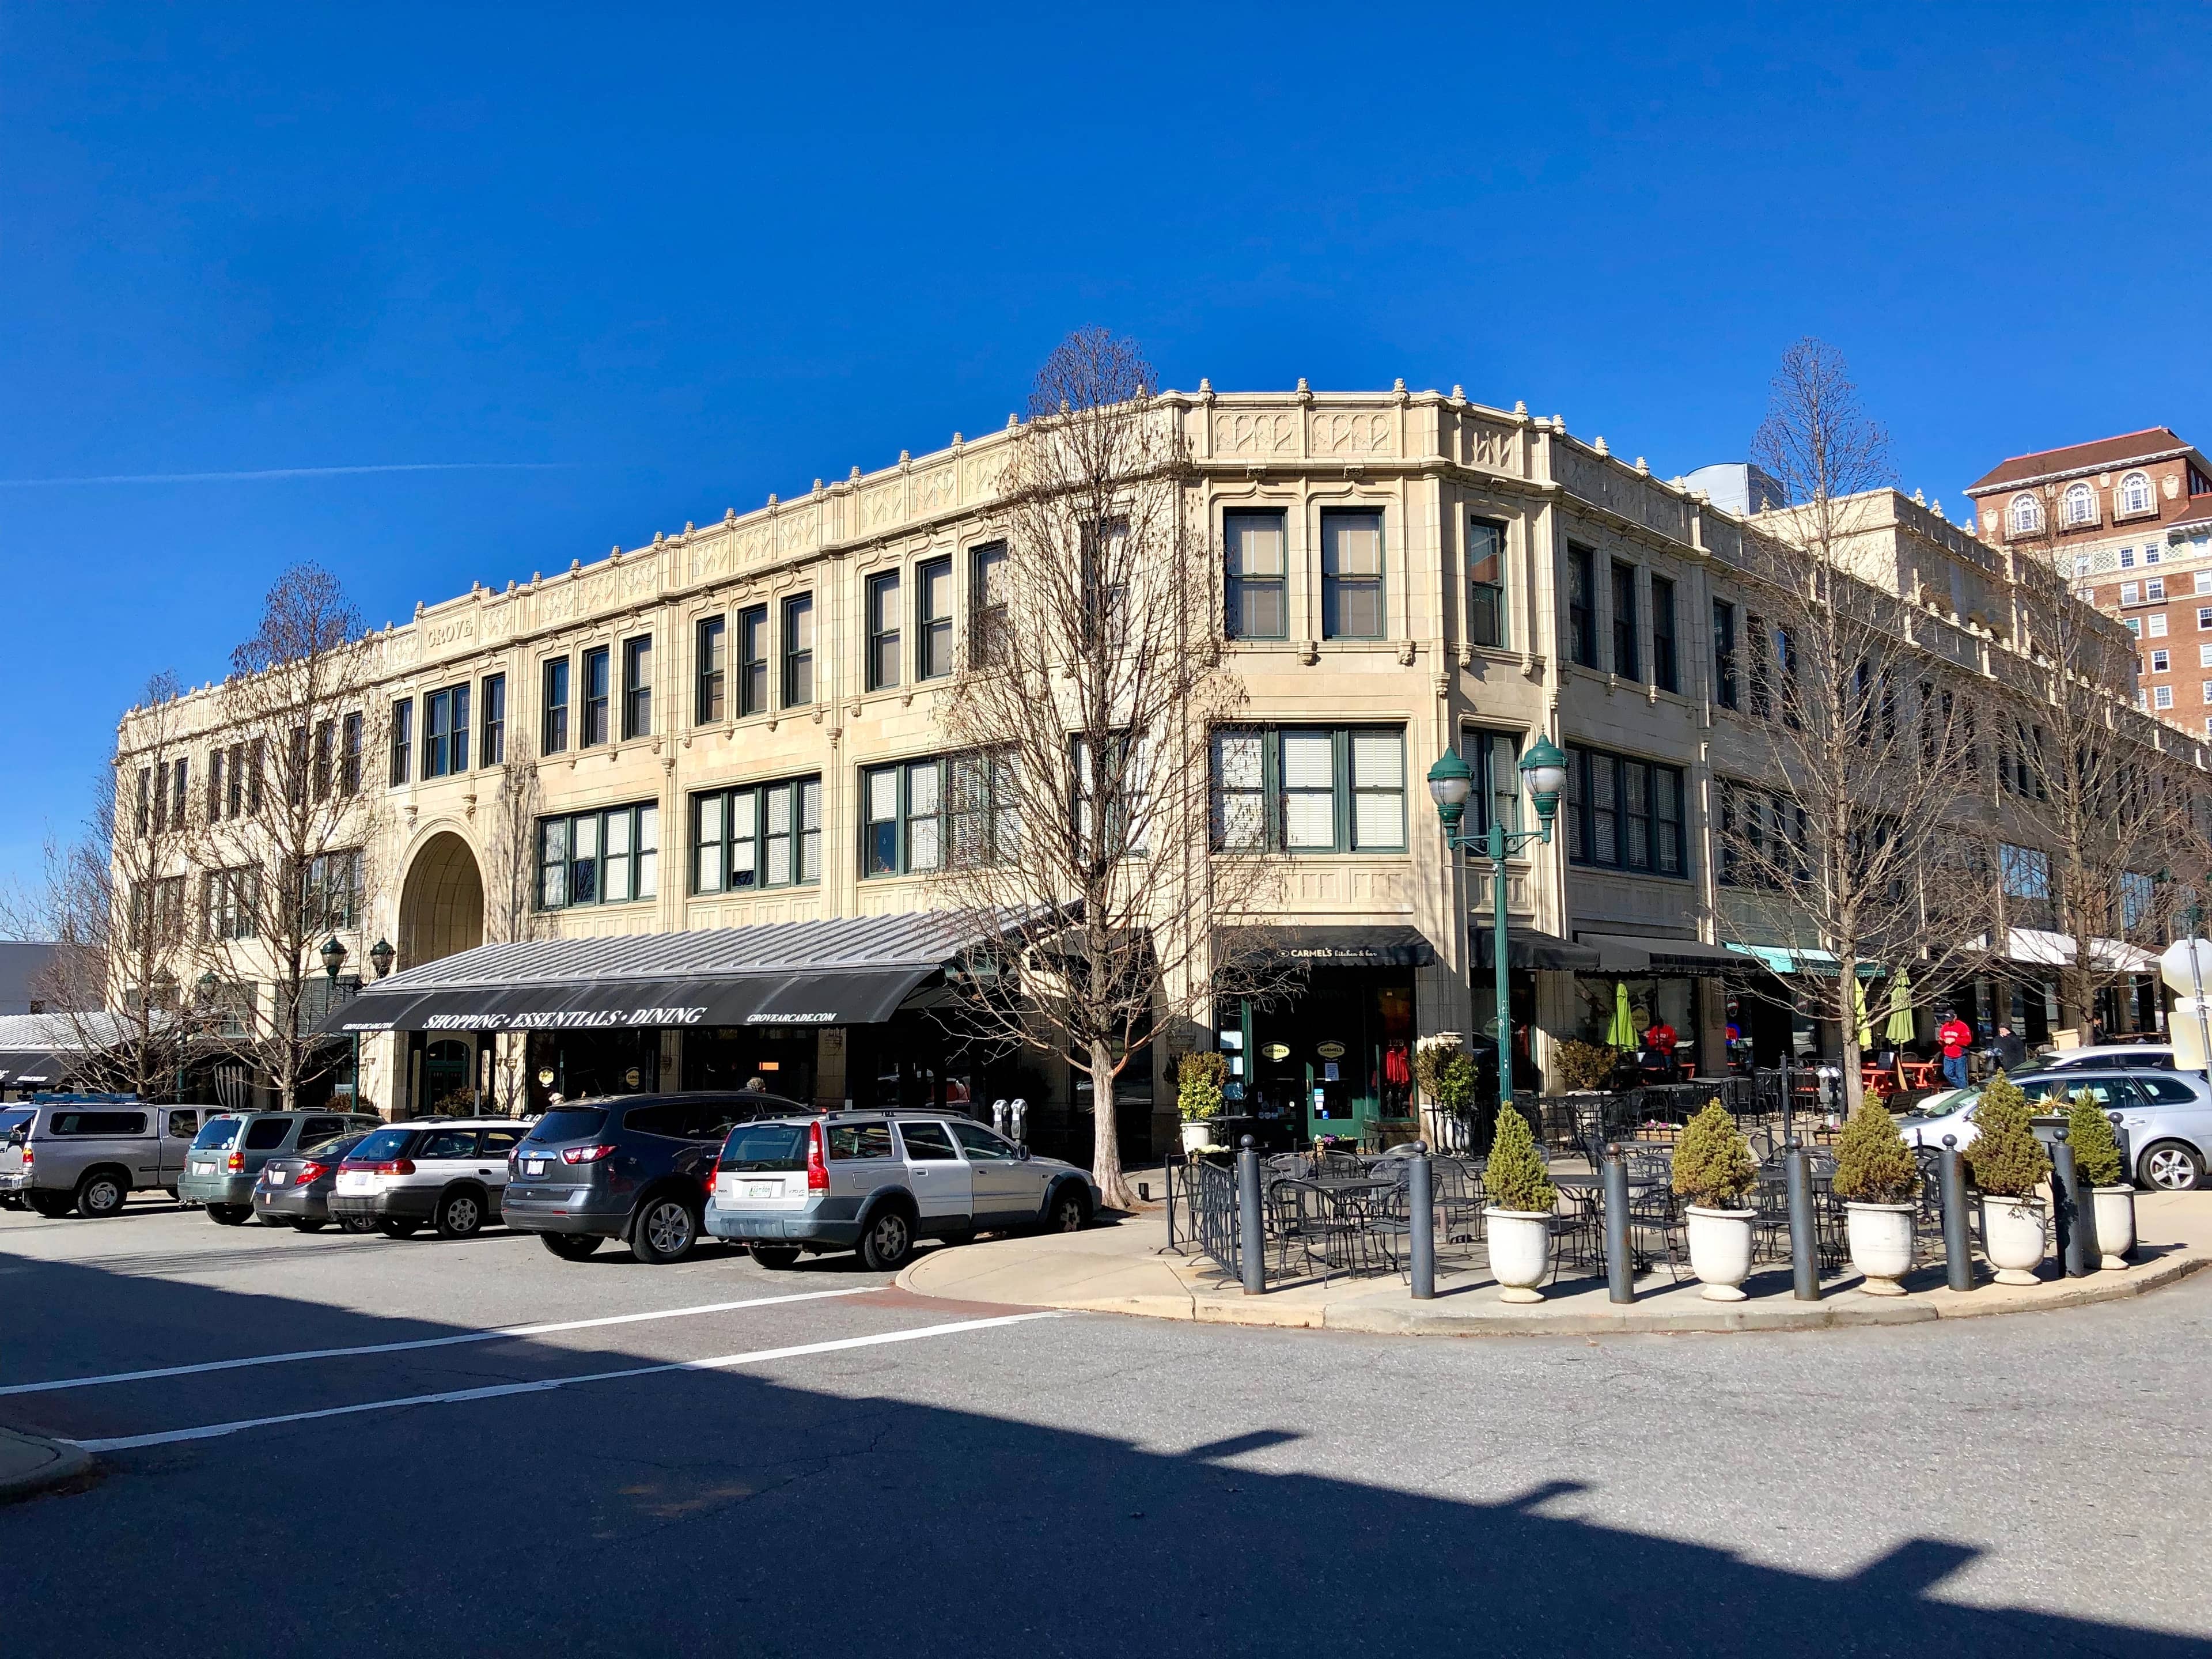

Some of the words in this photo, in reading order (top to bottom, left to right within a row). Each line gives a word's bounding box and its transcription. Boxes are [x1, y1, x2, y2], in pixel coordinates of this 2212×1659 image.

[428, 618, 473, 647] GROVE
[1291, 948, 1332, 957] CARMEL'S
[422, 1013, 505, 1029] SHOPPING
[508, 1010, 622, 1028] ESSENTIALS
[626, 1007, 708, 1025] DINING
[747, 1013, 837, 1022] GROVEARCADE.COM
